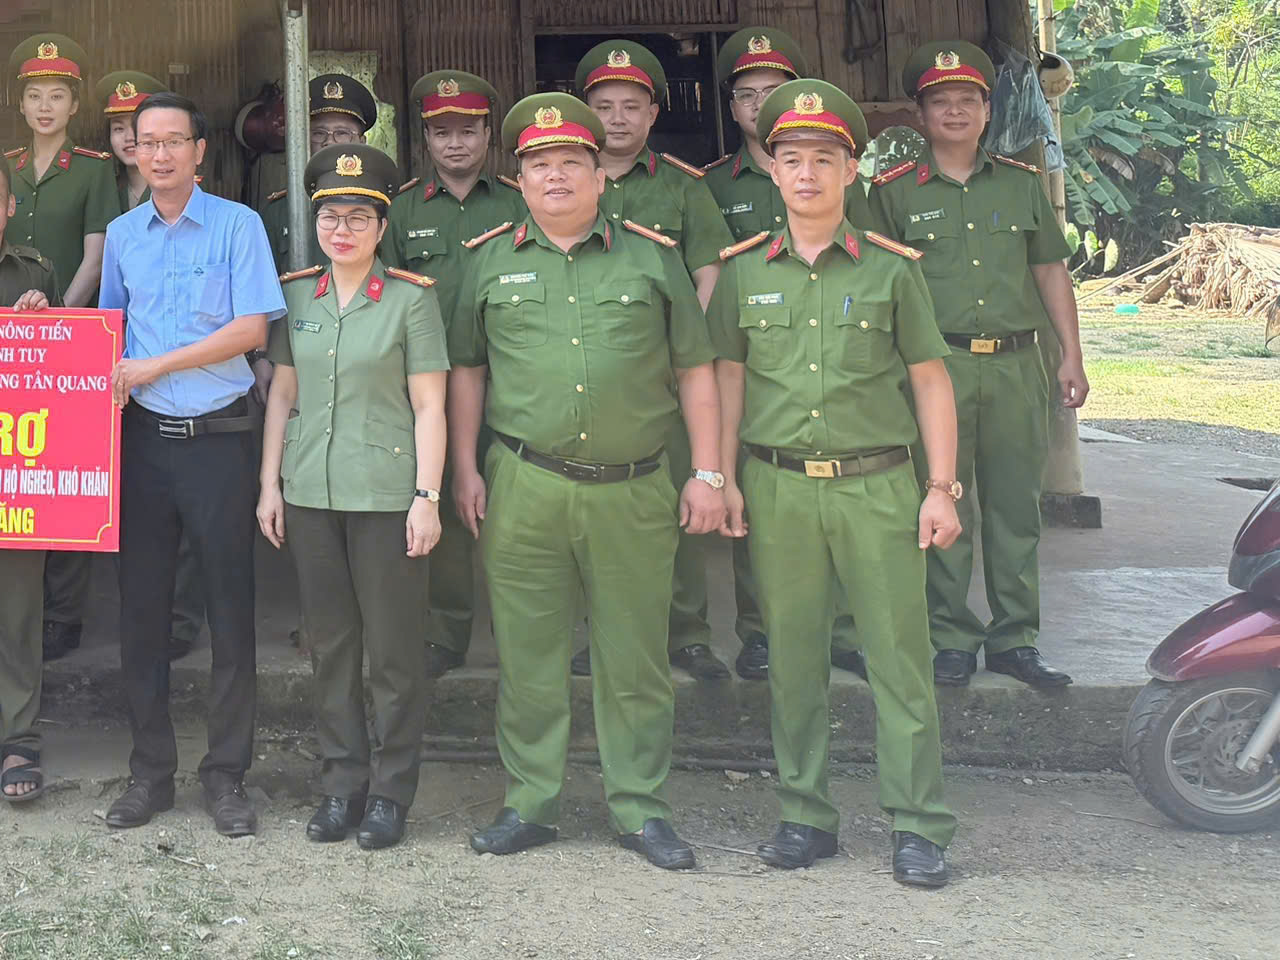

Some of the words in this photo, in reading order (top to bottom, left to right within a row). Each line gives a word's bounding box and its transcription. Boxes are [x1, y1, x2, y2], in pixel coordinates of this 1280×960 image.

[39, 320, 72, 340] TIẾN
[19, 349, 47, 363] TUY
[24, 373, 53, 390] TÂN
[56, 376, 107, 393] QUANG
[4, 464, 18, 499] HỘ
[20, 465, 56, 498] NGHÈO,
[58, 467, 79, 496] KHÓ
[80, 467, 109, 497] KHĂN
